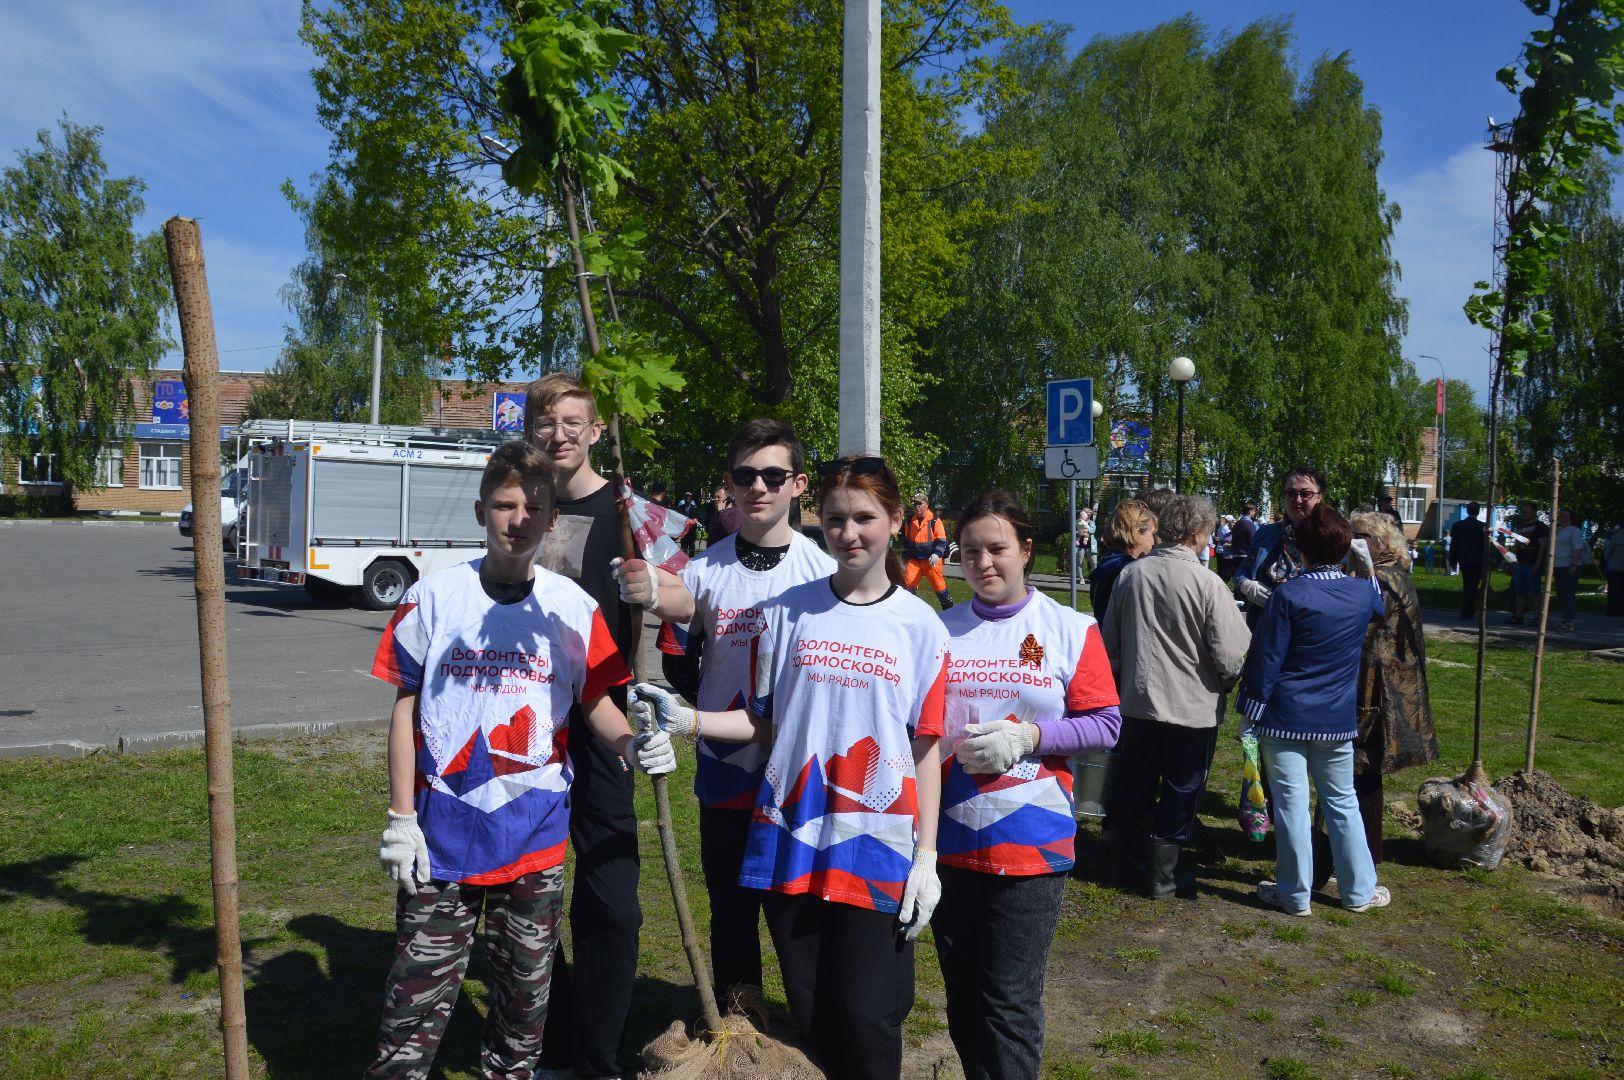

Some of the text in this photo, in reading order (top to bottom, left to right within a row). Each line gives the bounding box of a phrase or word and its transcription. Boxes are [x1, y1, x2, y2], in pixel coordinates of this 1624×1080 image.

[1060, 388, 1083, 438] P
[392, 449, 422, 459] АСМ 2
[731, 639, 748, 647] МЫ
[796, 639, 897, 666] ВОЛОНТЕРЫ
[451, 647, 549, 669] ВОЛОНТЕРЫ
[440, 663, 555, 685] ПОДМОСКОВЬЯ
[792, 654, 901, 687] ОДМОСКОВЬЯ
[470, 683, 527, 695] МЫ РЯДОМ
[807, 673, 869, 690] МЫ РЯДОМ
[959, 688, 1020, 700] МЫ РЯДОМ
